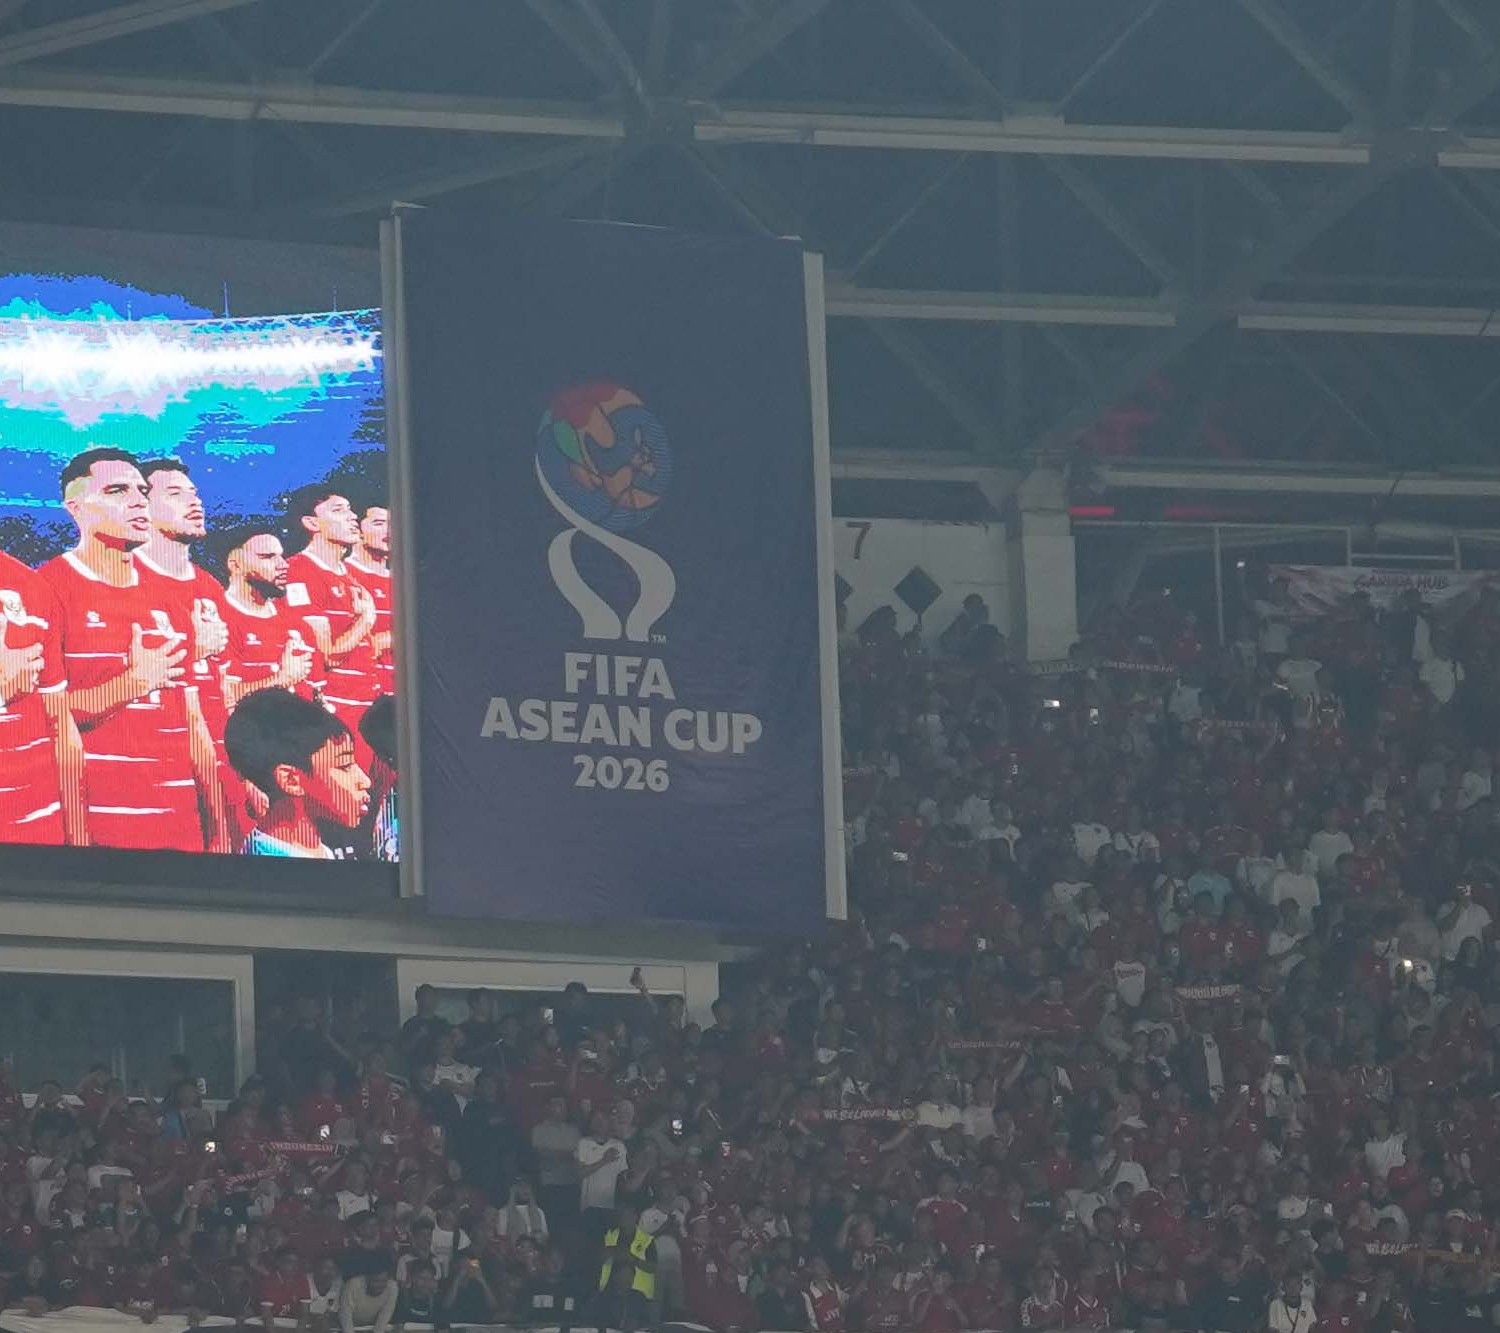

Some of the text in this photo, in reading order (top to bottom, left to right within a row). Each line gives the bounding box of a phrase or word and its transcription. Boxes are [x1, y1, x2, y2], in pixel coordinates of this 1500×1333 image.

[846, 521, 875, 562] 7
[564, 652, 676, 702] FIFA
[480, 696, 762, 757] ASEAN CUP
[573, 753, 671, 794] 2026
